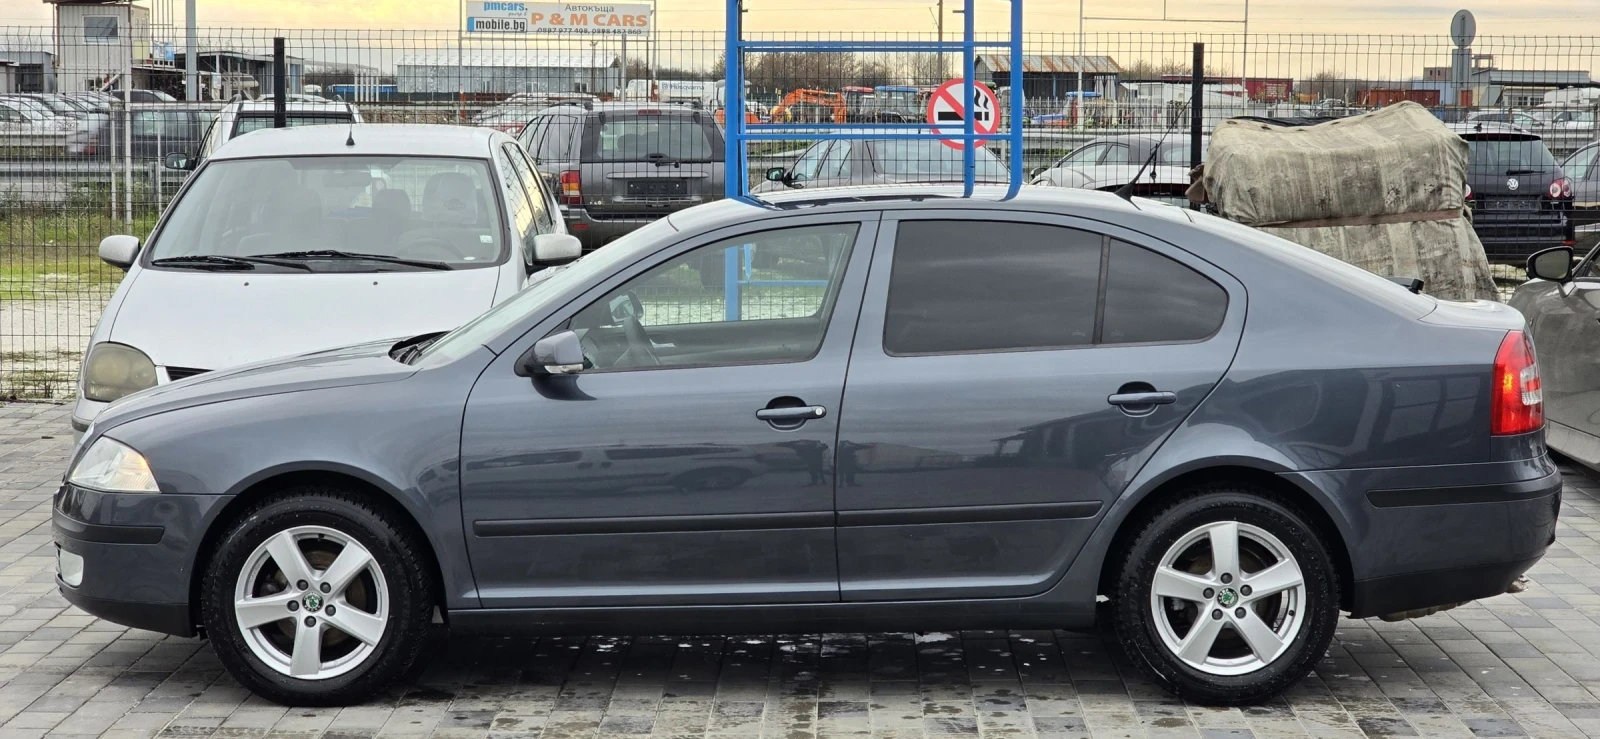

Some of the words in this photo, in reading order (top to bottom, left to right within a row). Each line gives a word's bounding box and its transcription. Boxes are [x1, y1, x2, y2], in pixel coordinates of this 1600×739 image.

[565, 4, 614, 13] Автокъща
[475, 19, 525, 32] mobile.bg
[531, 12, 544, 25] P
[549, 13, 565, 26] &
[570, 13, 588, 26] M
[593, 13, 648, 27] CARS
